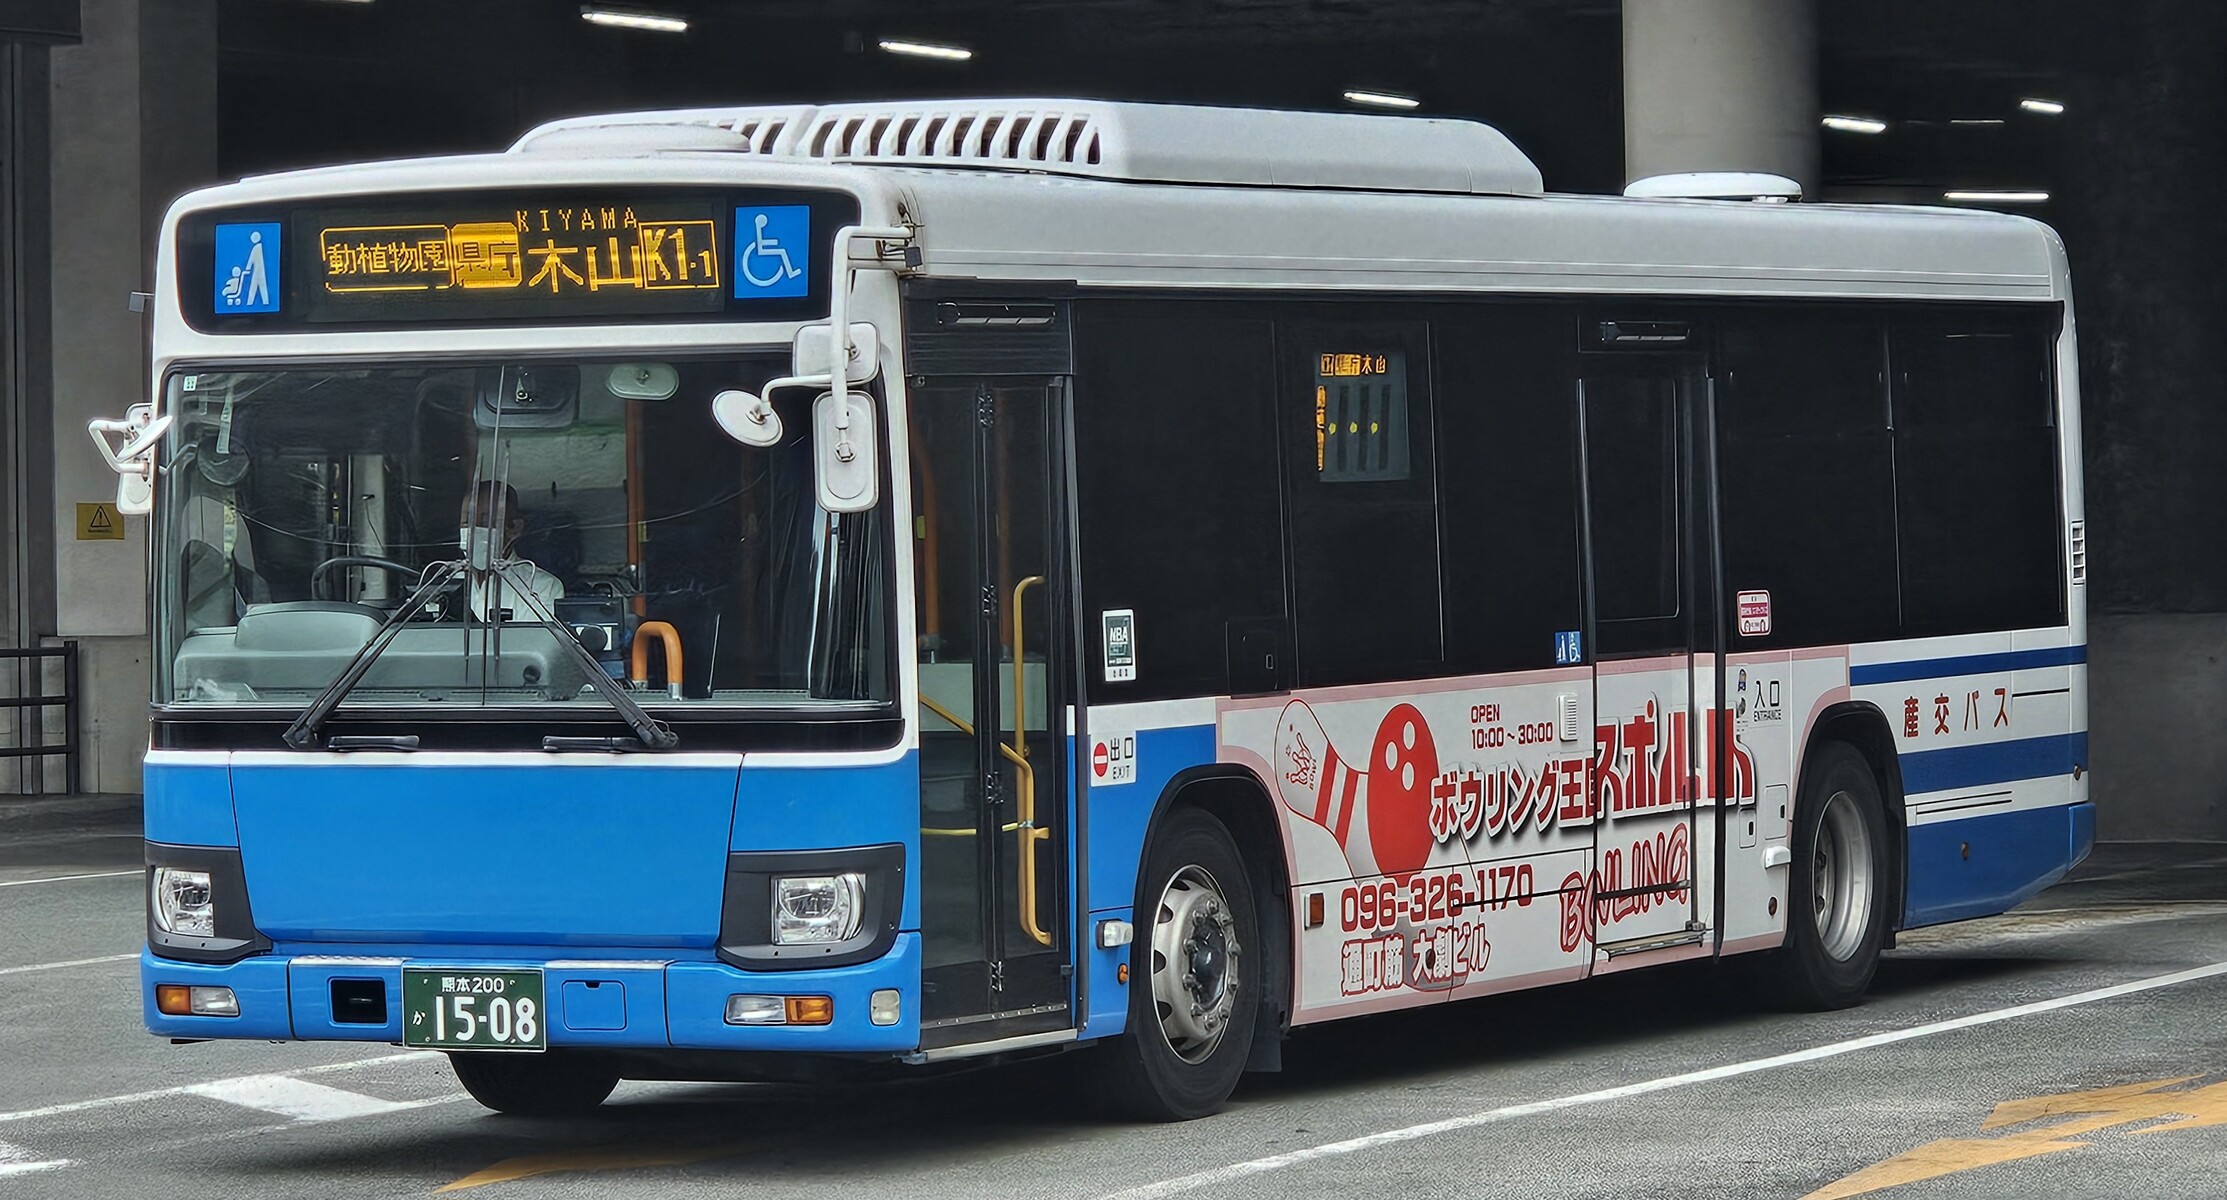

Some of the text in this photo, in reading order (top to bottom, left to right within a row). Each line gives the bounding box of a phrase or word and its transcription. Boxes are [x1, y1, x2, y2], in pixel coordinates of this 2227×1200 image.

[516, 207, 637, 232] KIYAMA
[327, 241, 449, 275] 動植物園
[455, 240, 519, 278] 県庁
[527, 236, 643, 293] 木山
[1753, 680, 1780, 709] 入口
[1471, 703, 1500, 724] OPEN
[1903, 687, 2009, 738] 産交バス
[1110, 737, 1134, 762] 出口
[1112, 764, 1131, 780] EXIT
[1340, 863, 1534, 932] 096-326-1170
[412, 995, 537, 1043] か 15-08
